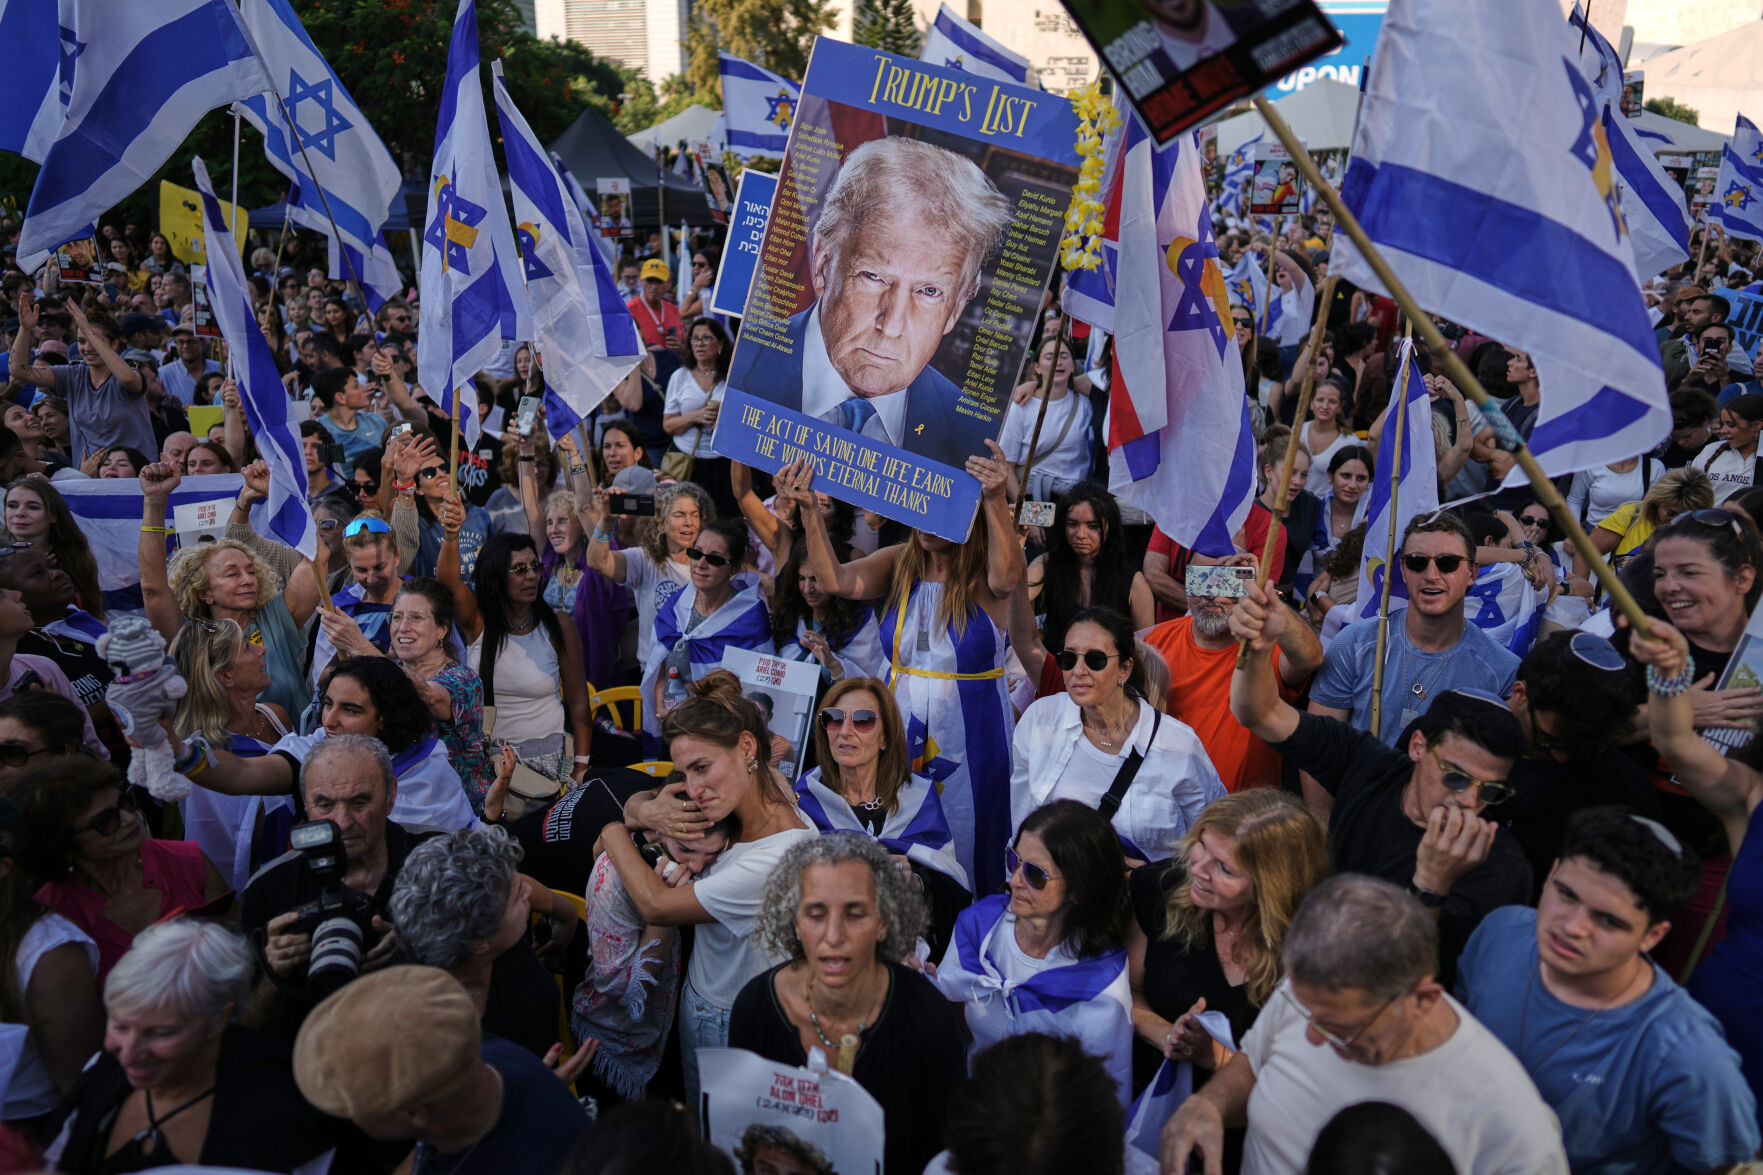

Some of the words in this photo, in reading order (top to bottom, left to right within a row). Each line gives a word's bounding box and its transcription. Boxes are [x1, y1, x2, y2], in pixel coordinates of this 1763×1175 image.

[1103, 20, 1162, 74] BRING
[868, 55, 977, 122] TRUMP'S
[979, 85, 1037, 138] LIST
[797, 172, 817, 184] Berman
[782, 188, 792, 197] Bar
[1022, 188, 1039, 200] David
[742, 216, 767, 228] כינו,
[771, 225, 790, 236] Nimrod
[790, 231, 806, 242] Cohen
[1029, 224, 1050, 236] Baruch
[1005, 239, 1018, 249] Guy
[779, 269, 794, 279] David
[992, 277, 1010, 288] Daniel
[1010, 282, 1027, 294] Perez
[1001, 290, 1017, 301] Chen
[984, 306, 992, 315] Oz
[971, 351, 983, 361] Ran
[986, 347, 994, 356] Or
[741, 404, 766, 430] THE
[766, 414, 794, 440] ACT
[794, 424, 814, 446] OF
[814, 431, 856, 466] SAVING
[856, 447, 882, 472] ONE
[882, 456, 912, 483] LIFE
[911, 466, 954, 498] EARNS
[755, 433, 779, 459] THE
[827, 460, 880, 498] ETERNAL
[884, 480, 930, 515] THANKS
[1722, 474, 1750, 485] ANGE
[71, 674, 102, 697] RING
[769, 1086, 796, 1104] ALON
[798, 1092, 823, 1110] OHEL
